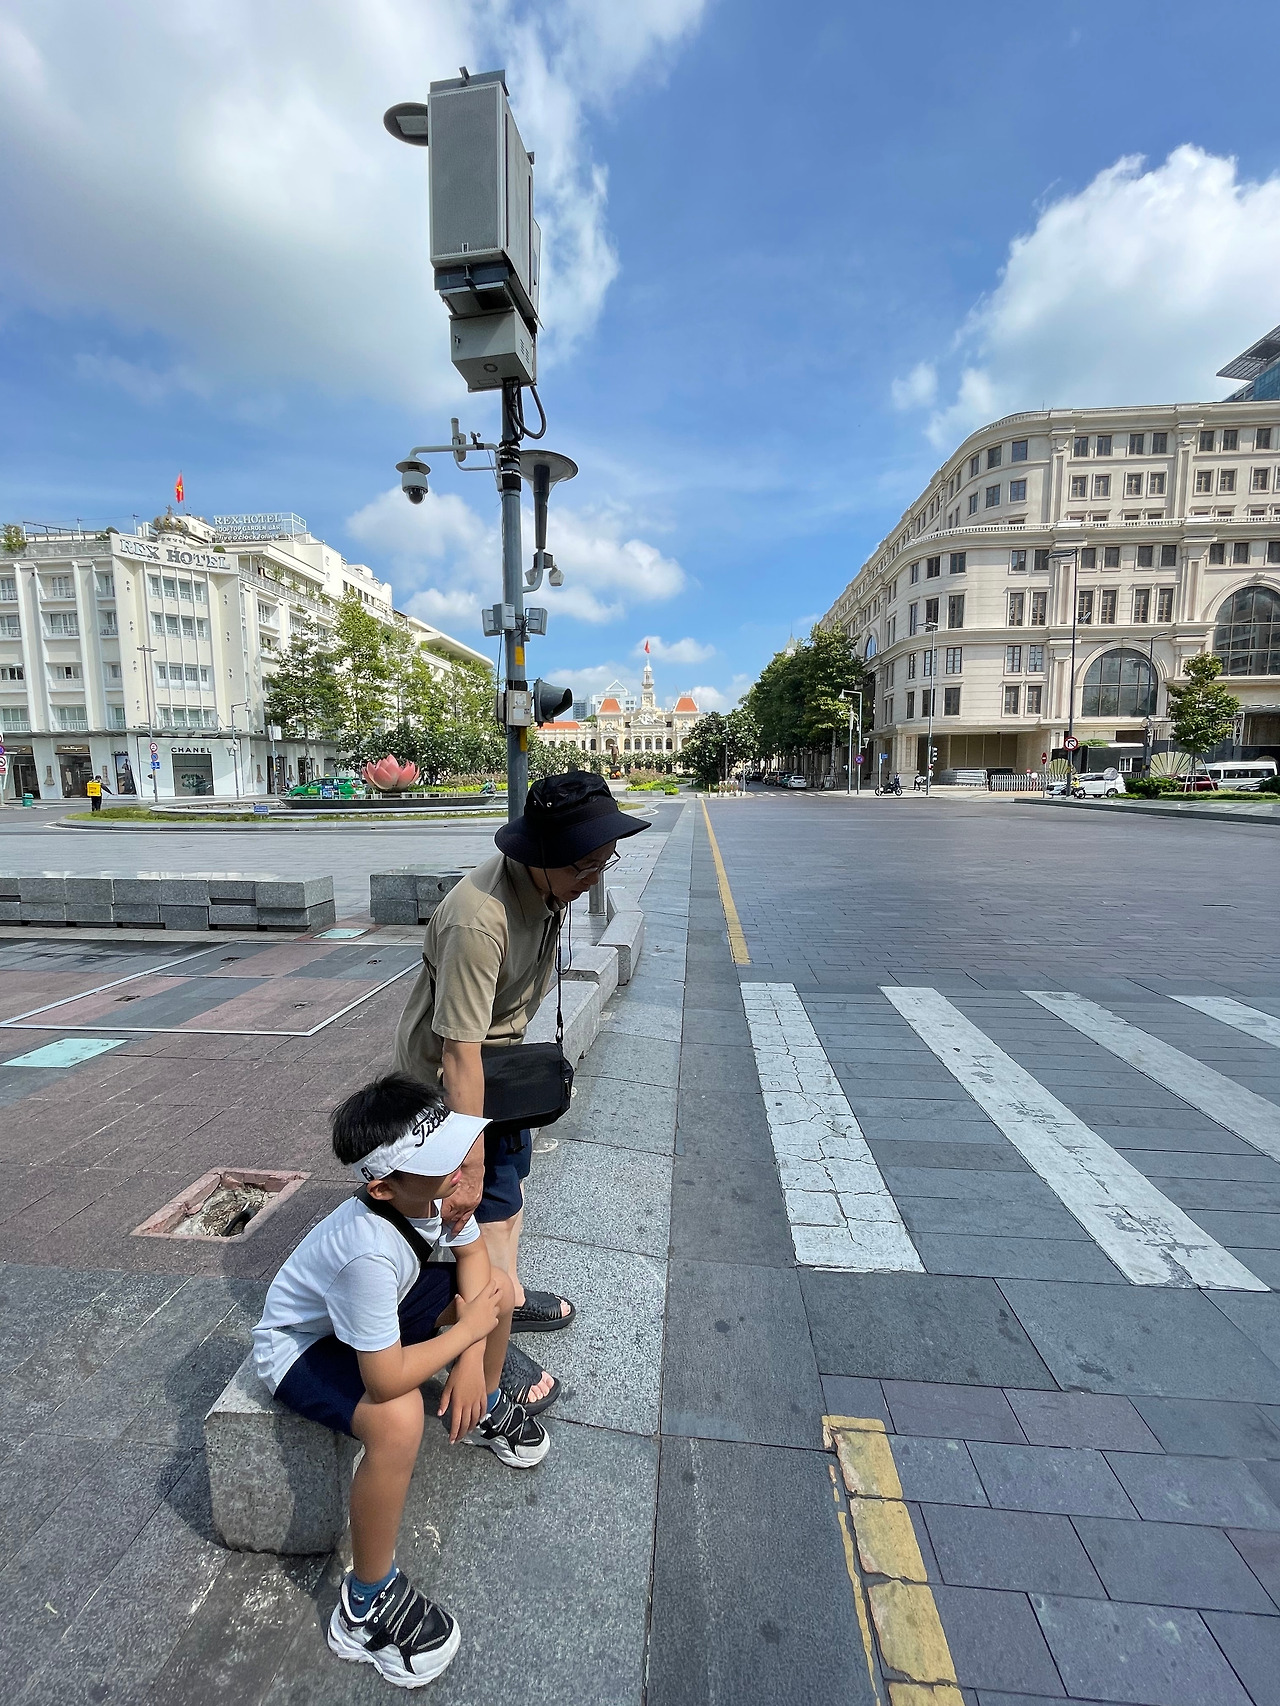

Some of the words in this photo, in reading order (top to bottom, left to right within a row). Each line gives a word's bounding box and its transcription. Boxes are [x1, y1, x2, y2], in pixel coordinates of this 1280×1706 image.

[214, 516, 241, 525] REX
[243, 513, 281, 524] HOTEL
[120, 539, 160, 559] REX
[166, 549, 230, 570] HOTEL
